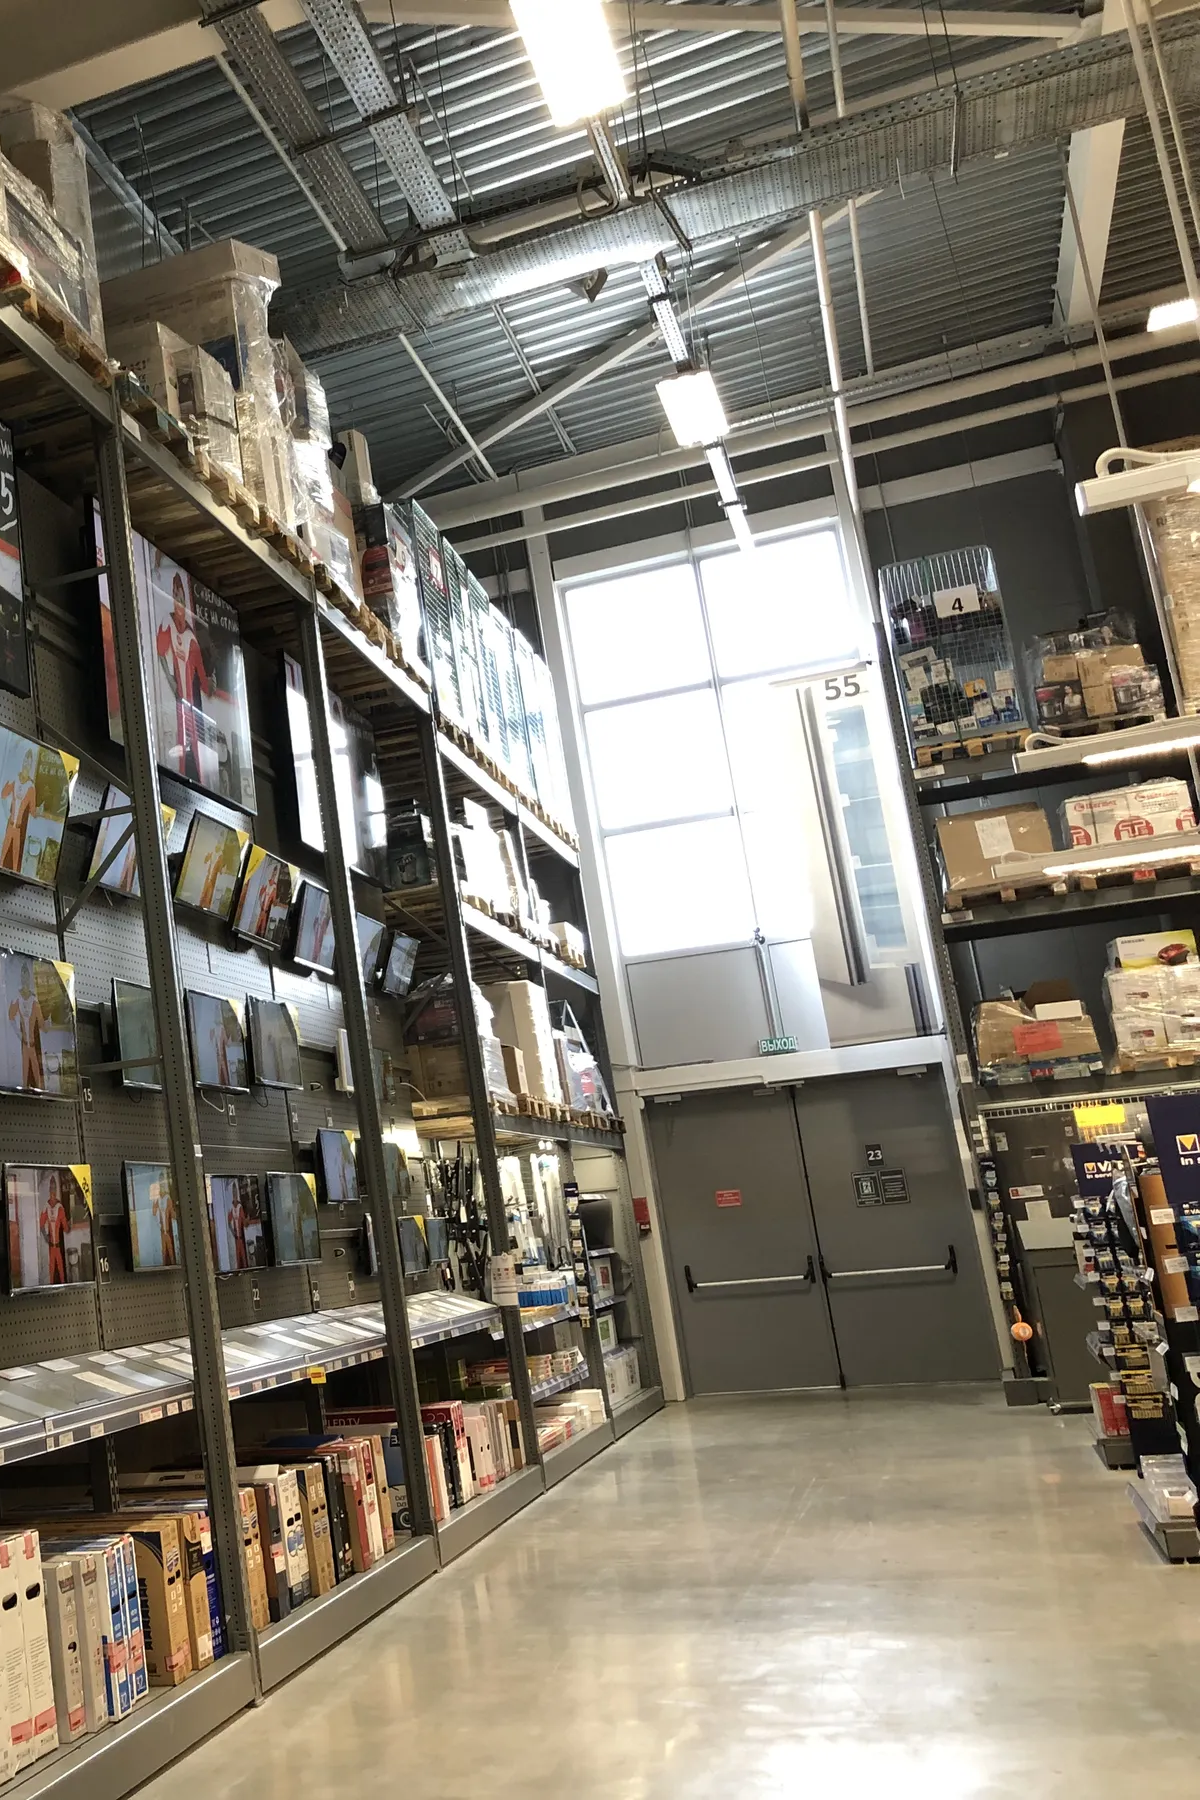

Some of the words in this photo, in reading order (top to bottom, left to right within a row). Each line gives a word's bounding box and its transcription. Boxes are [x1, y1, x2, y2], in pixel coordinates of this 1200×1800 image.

[0, 470, 15, 516] 5
[951, 597, 964, 613] 4
[824, 674, 860, 701] 55
[761, 1037, 796, 1052] ВЫХОД
[83, 1088, 92, 1101] 15
[867, 1150, 882, 1160] 23
[100, 1257, 109, 1271] 16
